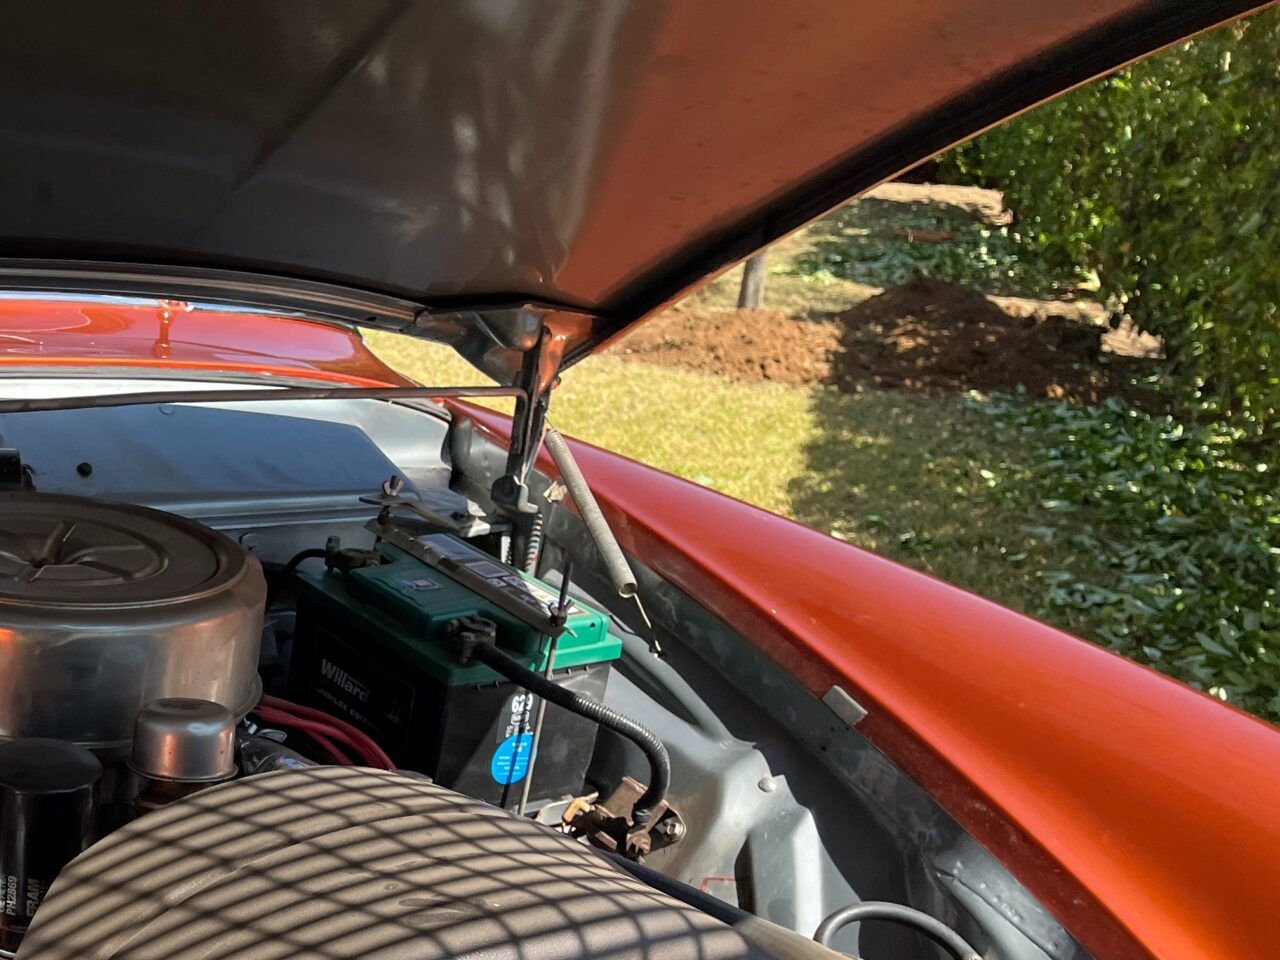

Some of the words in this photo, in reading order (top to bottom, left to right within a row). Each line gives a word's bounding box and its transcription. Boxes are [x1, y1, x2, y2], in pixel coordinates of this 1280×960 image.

[321, 657, 371, 703] Willard
[511, 693, 533, 713] 629
[6, 875, 18, 916] PH2869
[25, 877, 40, 918] FRAM
